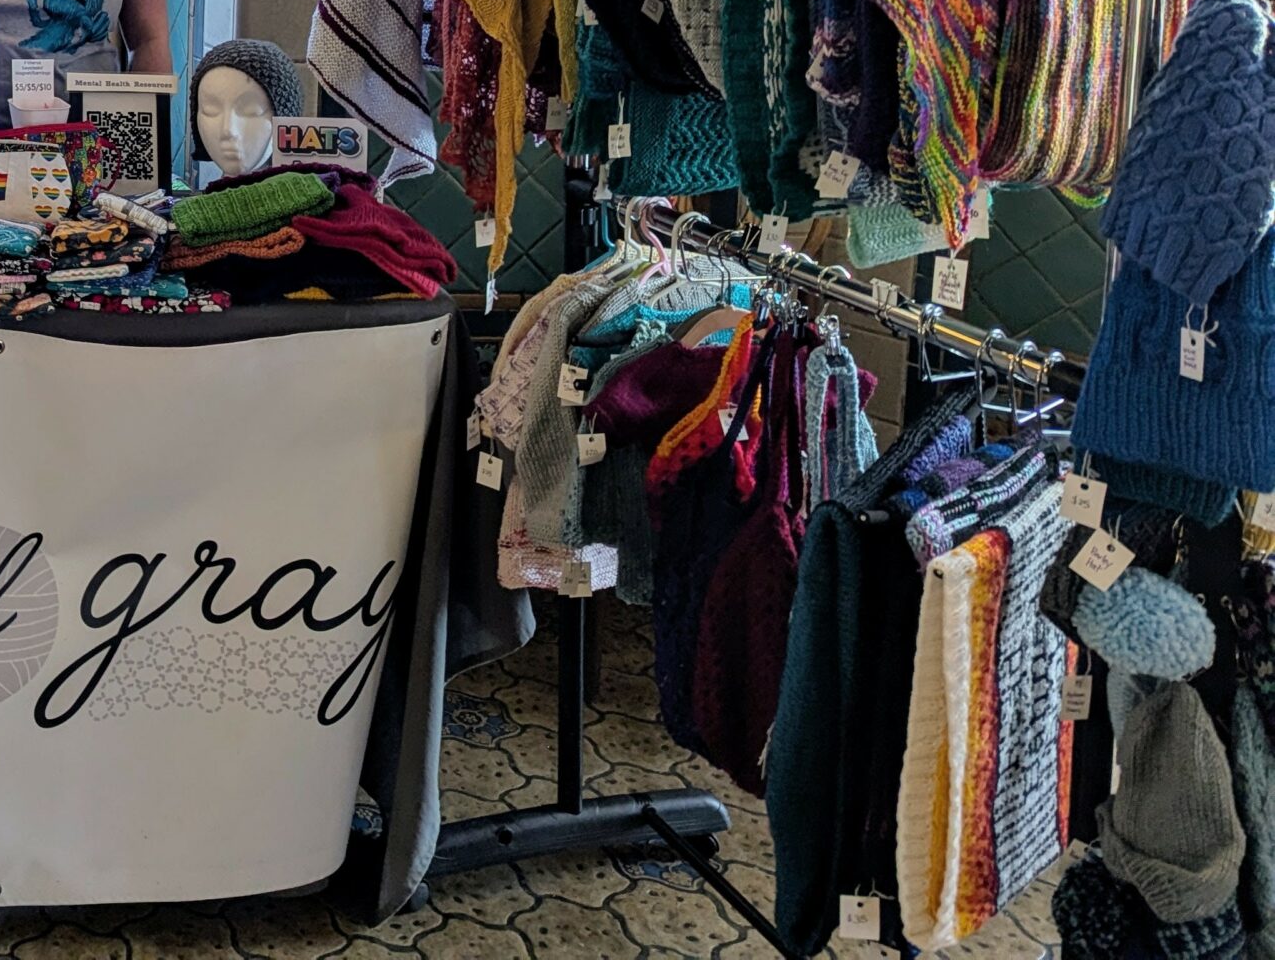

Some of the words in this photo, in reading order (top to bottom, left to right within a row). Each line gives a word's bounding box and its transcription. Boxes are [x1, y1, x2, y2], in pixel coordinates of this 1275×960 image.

[14, 82, 52, 92] $5/$5/$10
[75, 79, 102, 87] Mental
[278, 125, 360, 156] HATS
[33, 540, 400, 728] gray
